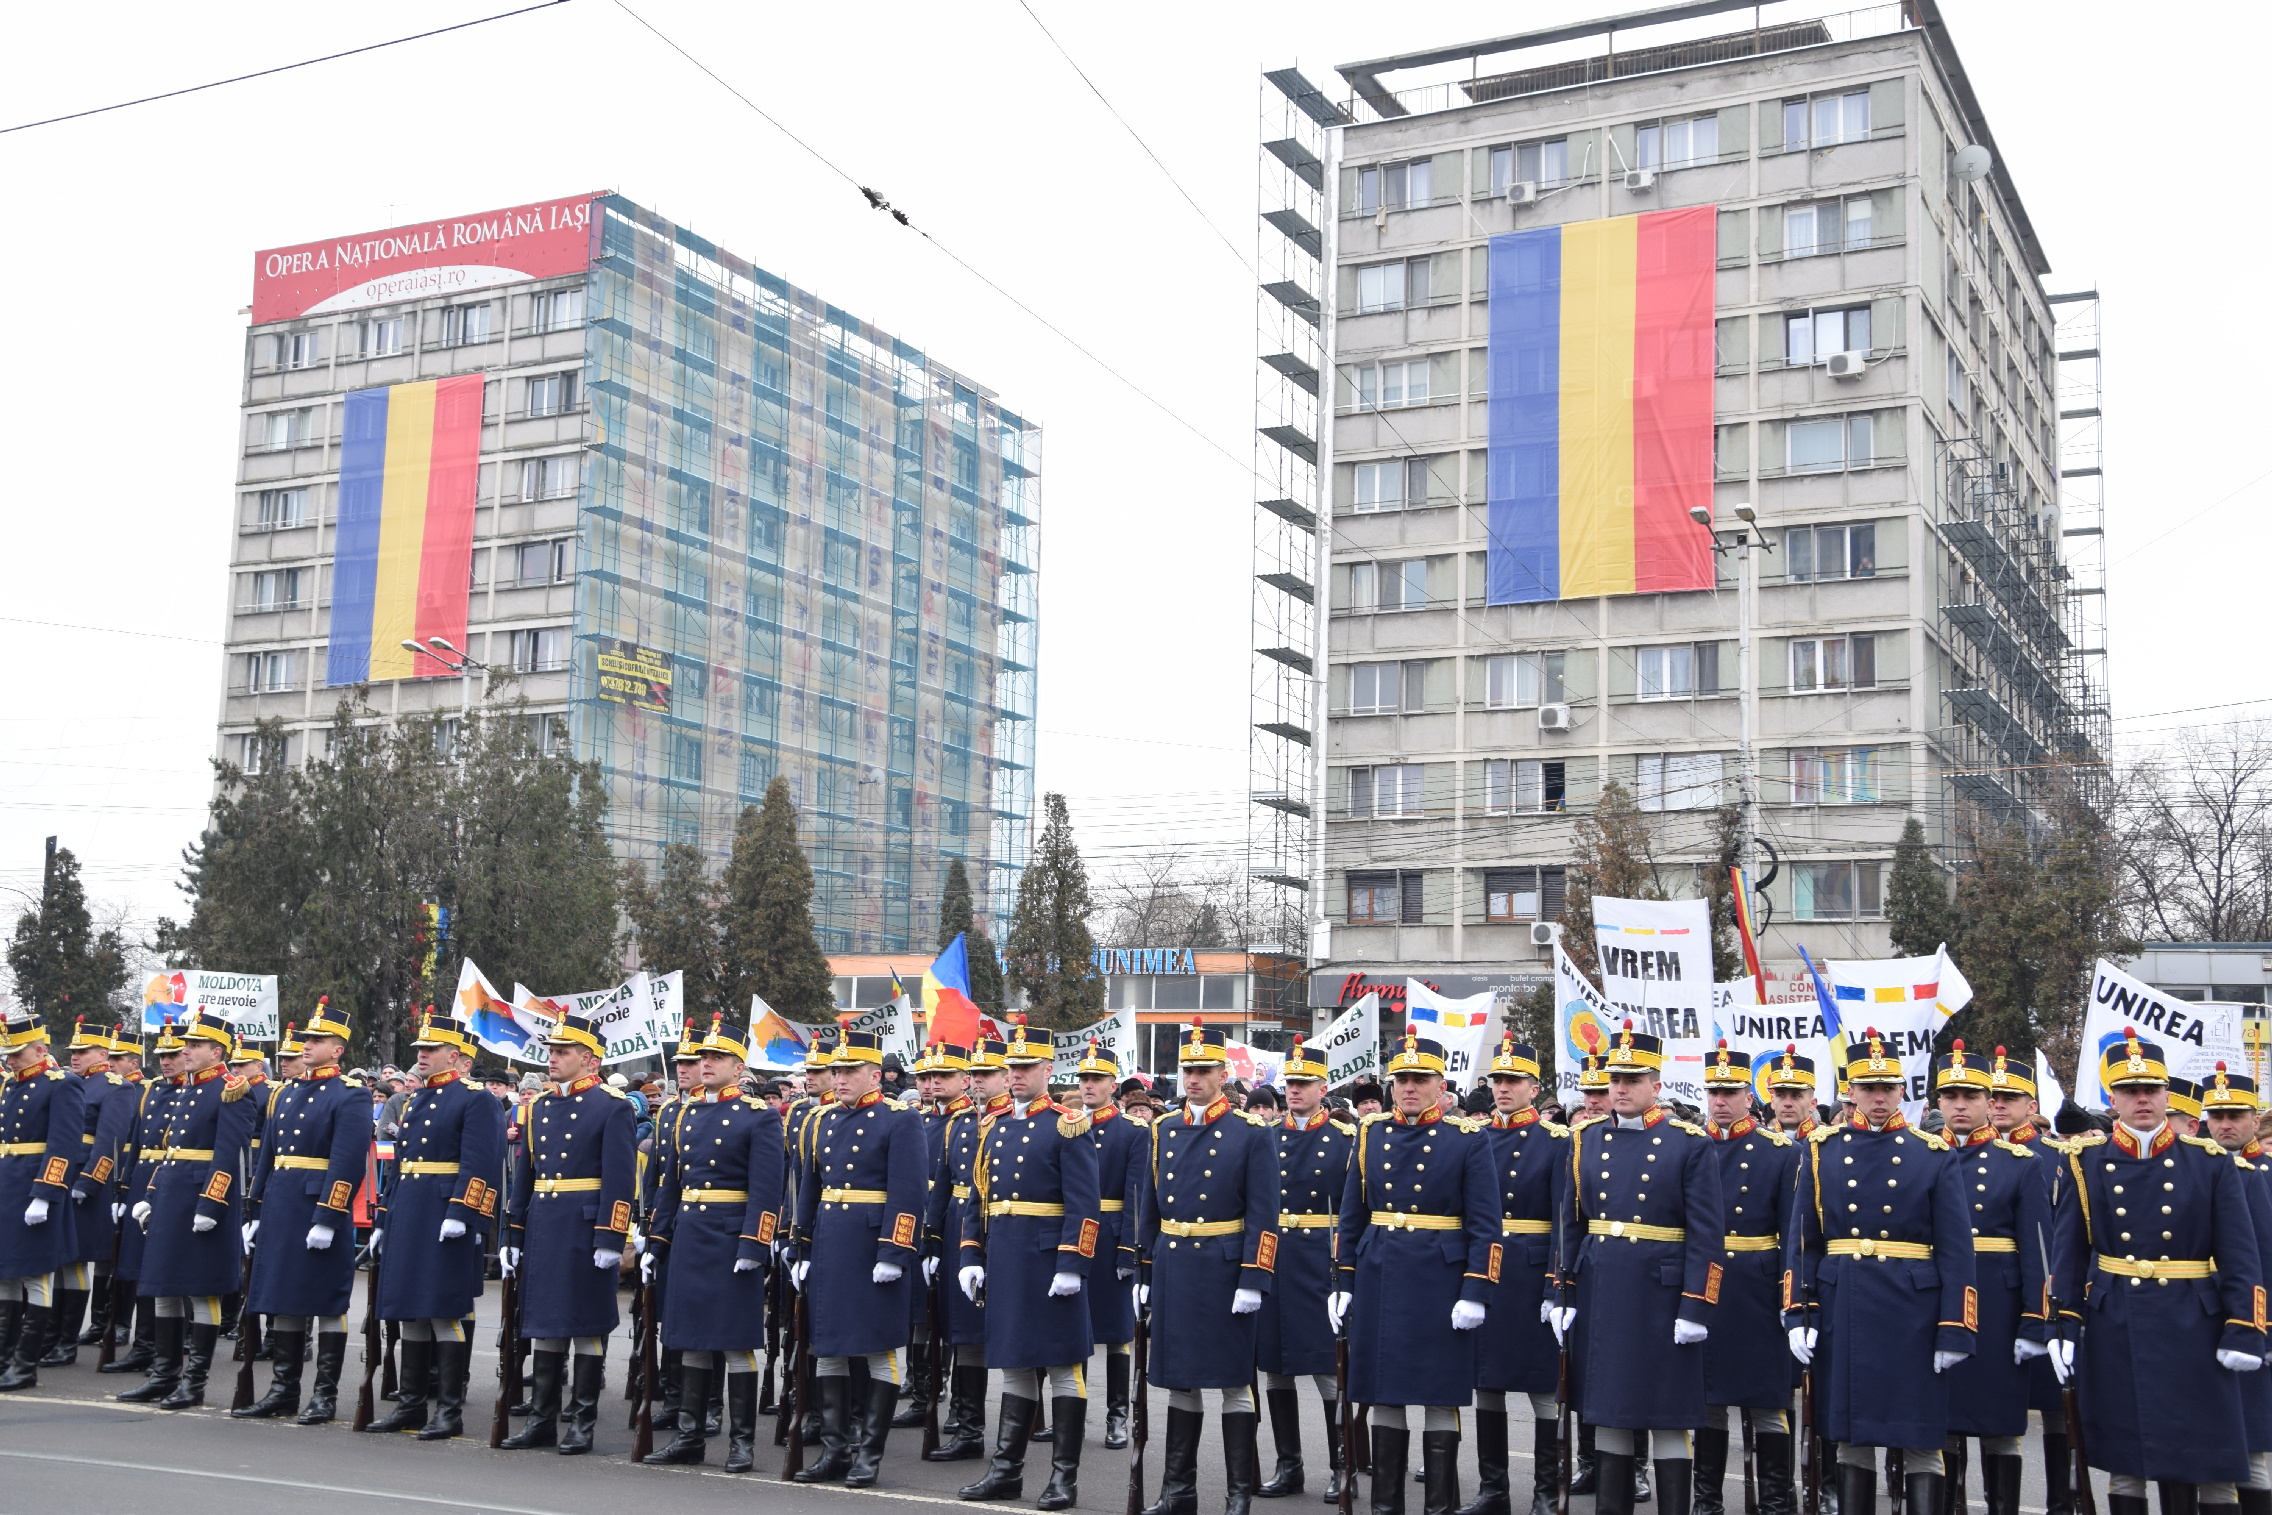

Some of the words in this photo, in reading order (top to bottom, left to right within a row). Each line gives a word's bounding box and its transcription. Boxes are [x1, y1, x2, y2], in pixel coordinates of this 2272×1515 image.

[265, 249, 329, 278] OPERA
[452, 207, 544, 248] ROMÂNĂ
[366, 268, 466, 302] operaiasi.ro
[1601, 945, 1682, 982] VREM
[198, 974, 262, 992] MOLDOVA
[198, 993, 216, 1005] are
[217, 994, 257, 1008] nevoie
[219, 1007, 229, 1017] de
[2097, 974, 2204, 1047] UNIREA
[1053, 1016, 1122, 1049] LDOVA
[1325, 1027, 1361, 1050] voie
[1732, 1014, 1828, 1040] UNIREA
